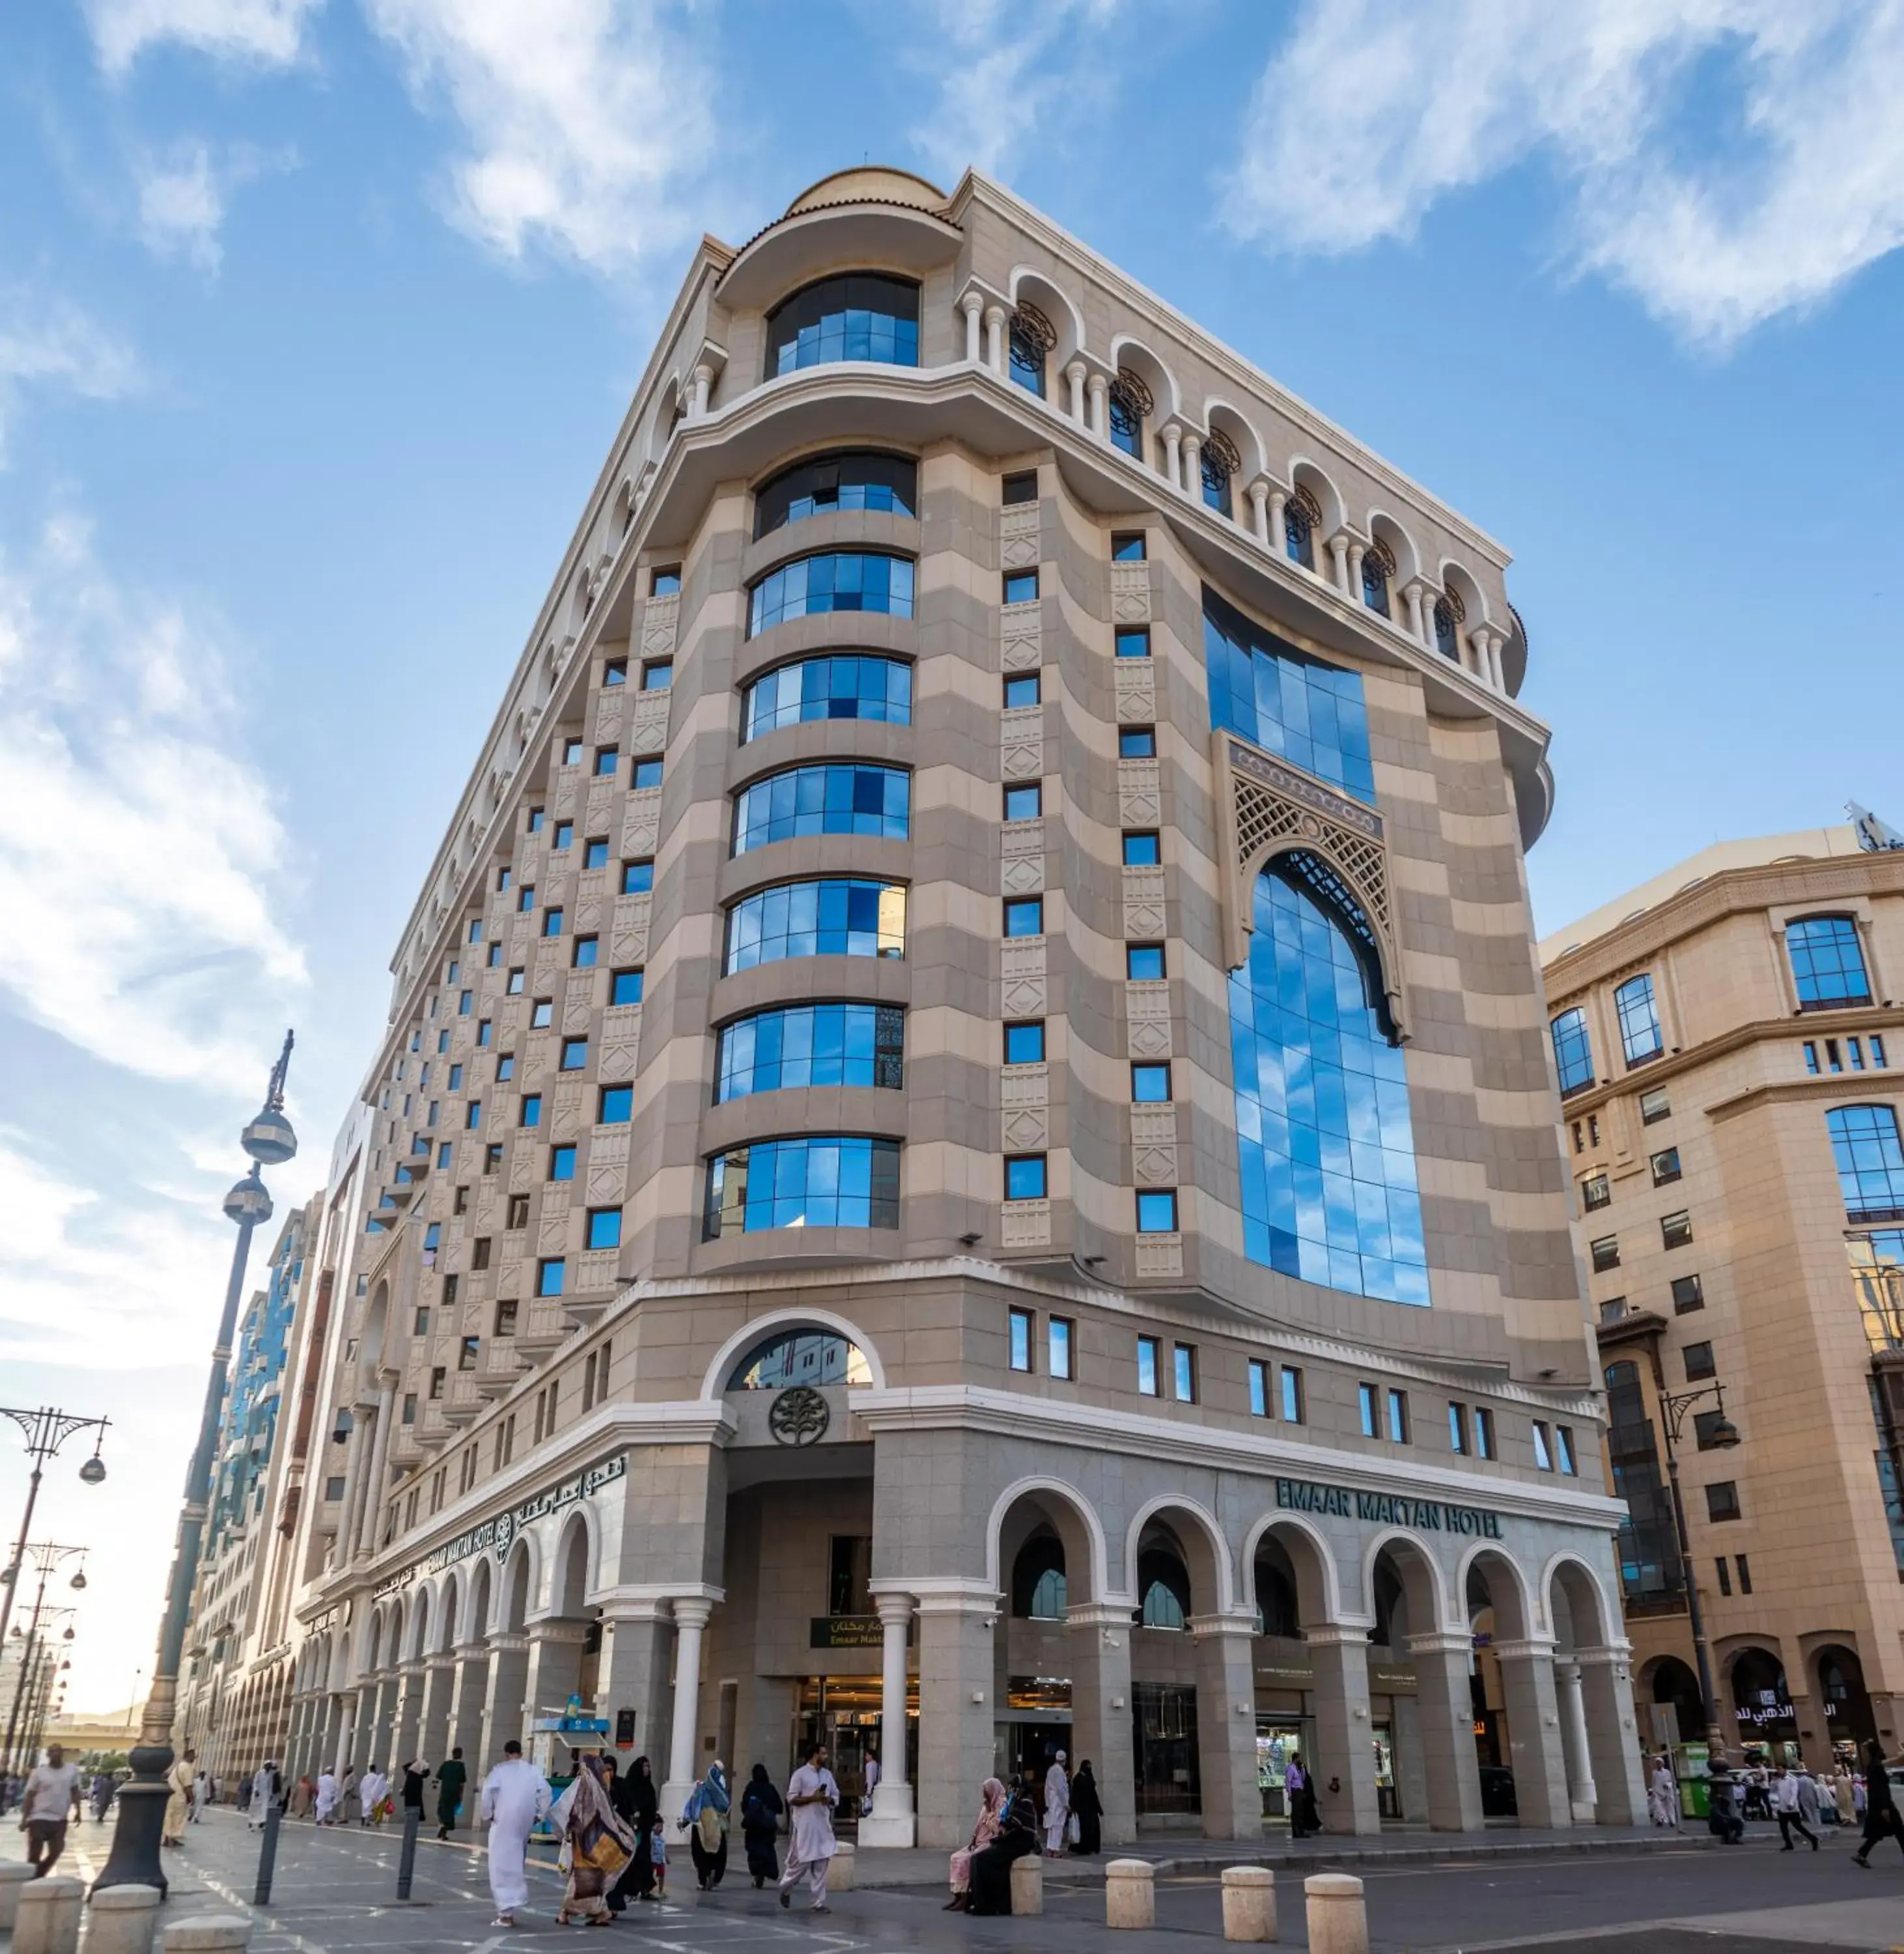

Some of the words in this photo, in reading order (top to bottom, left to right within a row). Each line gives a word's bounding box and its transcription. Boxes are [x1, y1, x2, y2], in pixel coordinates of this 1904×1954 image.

[1276, 1479, 1351, 1518] EMAAR
[1356, 1493, 1441, 1531] MAKTAN
[1445, 1507, 1504, 1539] HOTEL
[447, 1531, 474, 1565] MAKTAN
[473, 1521, 495, 1553] HOTEL
[830, 1635, 858, 1645] Emaar
[861, 1634, 884, 1645] Makt
[1753, 1703, 1794, 1727] الذهبي
